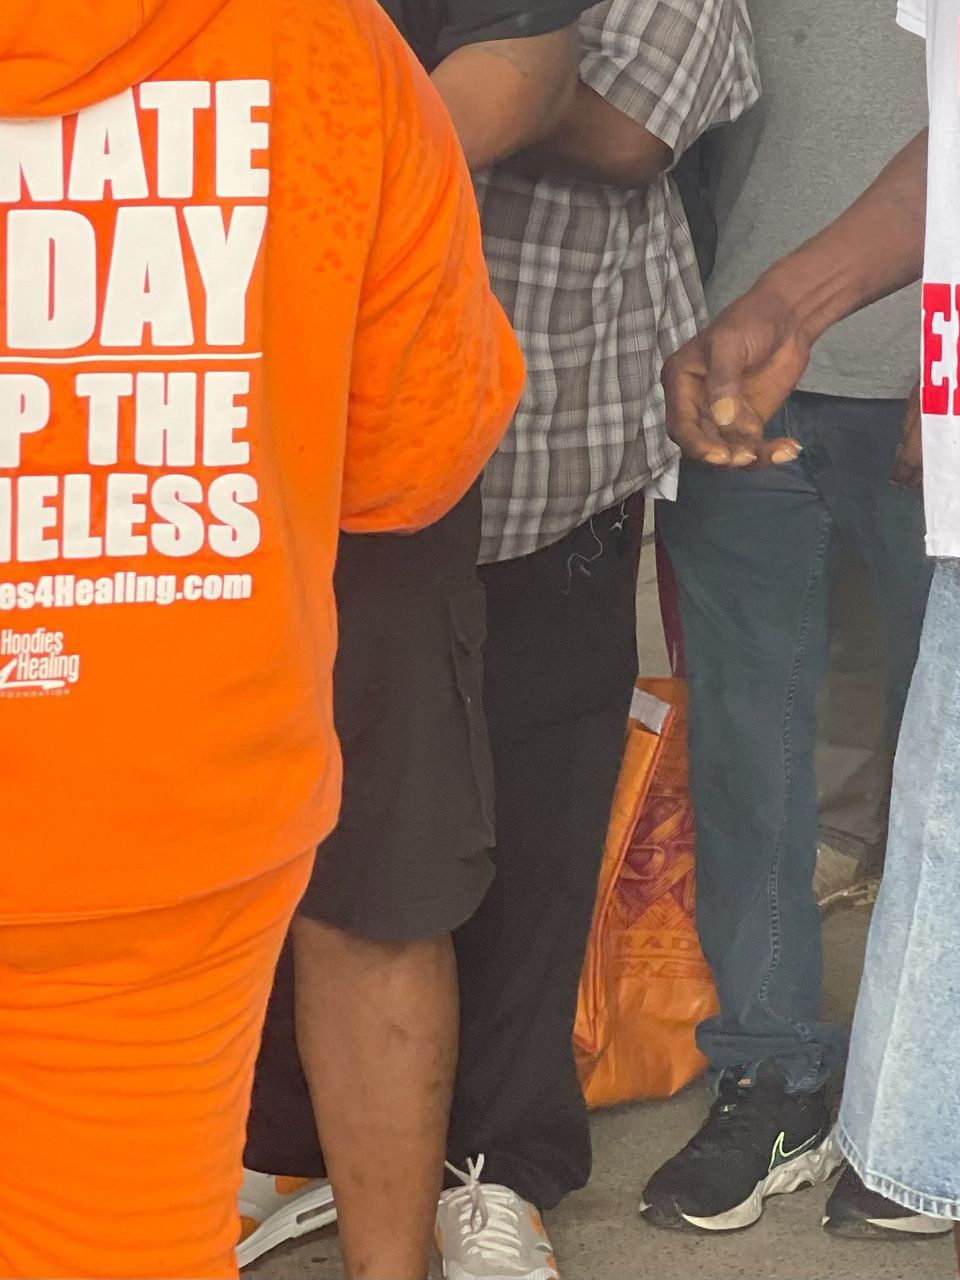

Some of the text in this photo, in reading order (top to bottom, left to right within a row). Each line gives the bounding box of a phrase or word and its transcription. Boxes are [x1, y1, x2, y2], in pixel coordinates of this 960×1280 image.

[6, 205, 268, 350] DAY
[75, 371, 251, 467] THE
[0, 627, 64, 655] Hoodies
[16, 652, 80, 683] Healing
